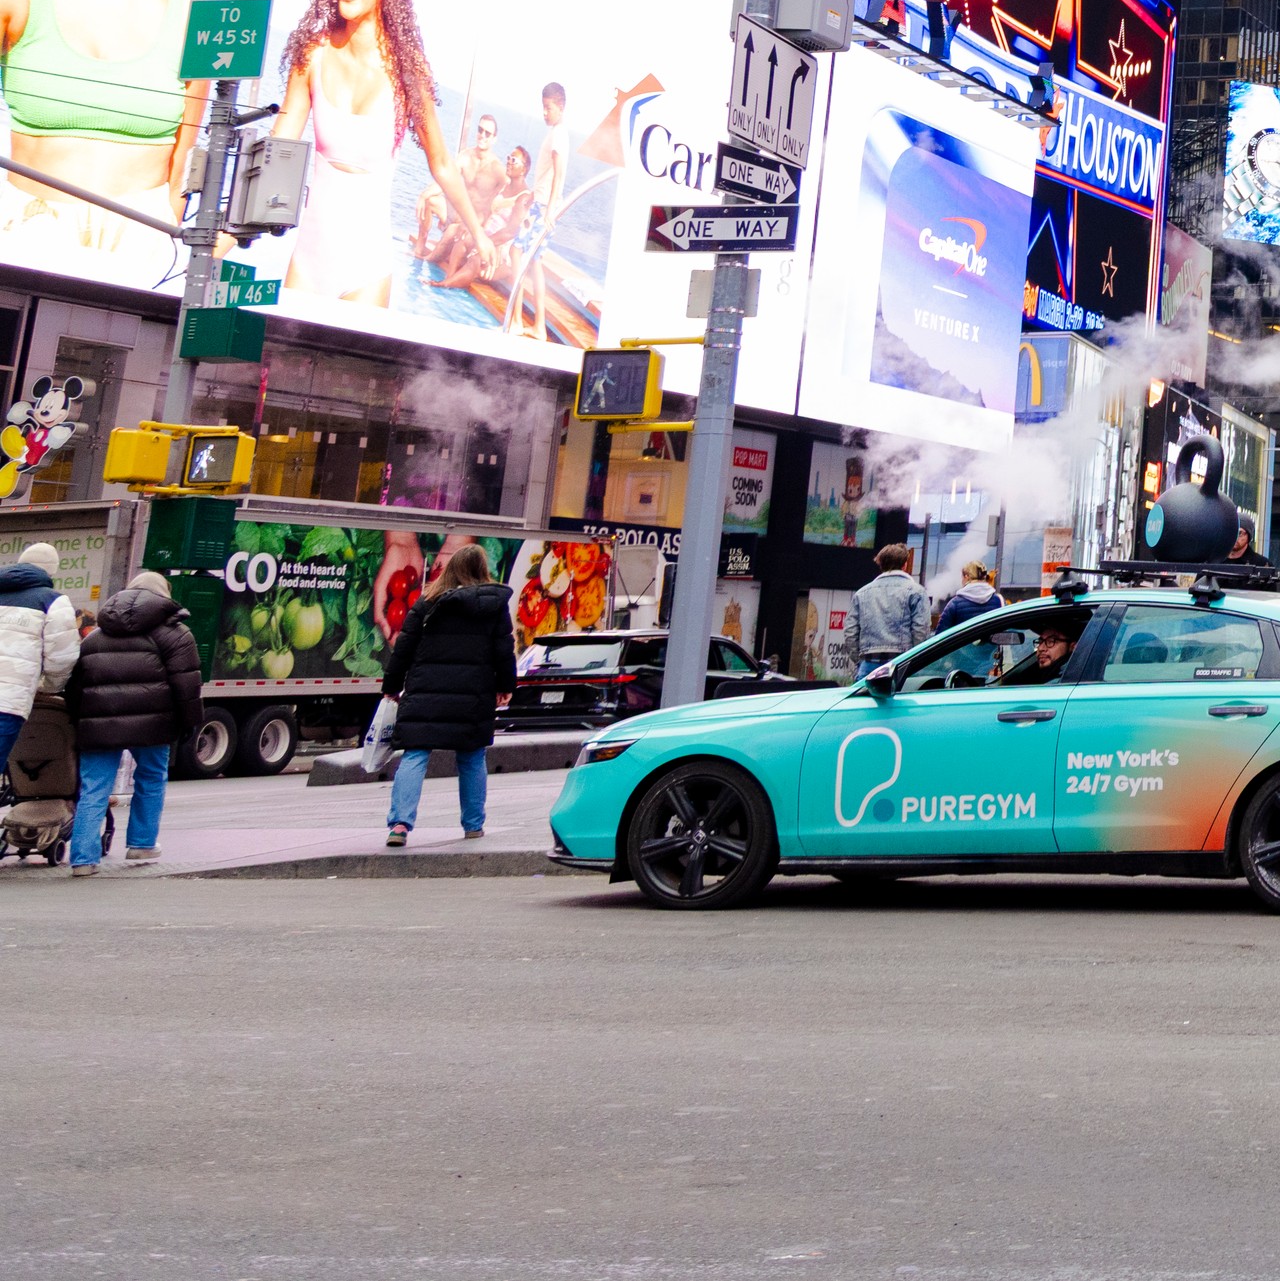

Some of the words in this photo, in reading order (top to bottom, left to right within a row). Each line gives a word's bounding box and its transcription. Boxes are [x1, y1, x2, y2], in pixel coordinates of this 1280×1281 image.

[220, 8, 241, 23] TO
[196, 30, 212, 45] W
[213, 30, 238, 45] 45
[240, 29, 257, 45] St
[732, 109, 752, 133] ONLY
[757, 121, 776, 146] ONLY
[782, 135, 805, 159] ONLY
[1062, 91, 1163, 200] HOUSTON
[729, 161, 754, 184] ONE
[765, 172, 789, 194] WAY
[672, 220, 714, 238] ONE
[736, 220, 779, 238] WAY
[230, 265, 237, 282] 7
[230, 285, 241, 304] W
[245, 284, 263, 303] 46
[267, 282, 276, 294] St
[914, 308, 970, 340] VENTURE
[971, 325, 979, 343] X
[735, 450, 748, 465] POP
[748, 452, 766, 468] MART
[732, 476, 763, 493] COMING
[735, 492, 757, 506] SOON
[54, 538, 81, 552] me
[86, 535, 104, 550] to
[616, 527, 659, 546] POLO
[728, 553, 751, 563] POLO
[280, 561, 293, 574] At
[293, 562, 309, 575] the
[310, 563, 336, 576] heart
[336, 564, 347, 577] of
[278, 576, 299, 588] food
[299, 577, 316, 588] and
[316, 577, 346, 590] service
[1066, 751, 1113, 770] New
[1117, 749, 1179, 768] York's
[1066, 775, 1111, 795] 24/7
[1114, 775, 1164, 798] Gym
[902, 792, 1037, 823] PUREGYM
